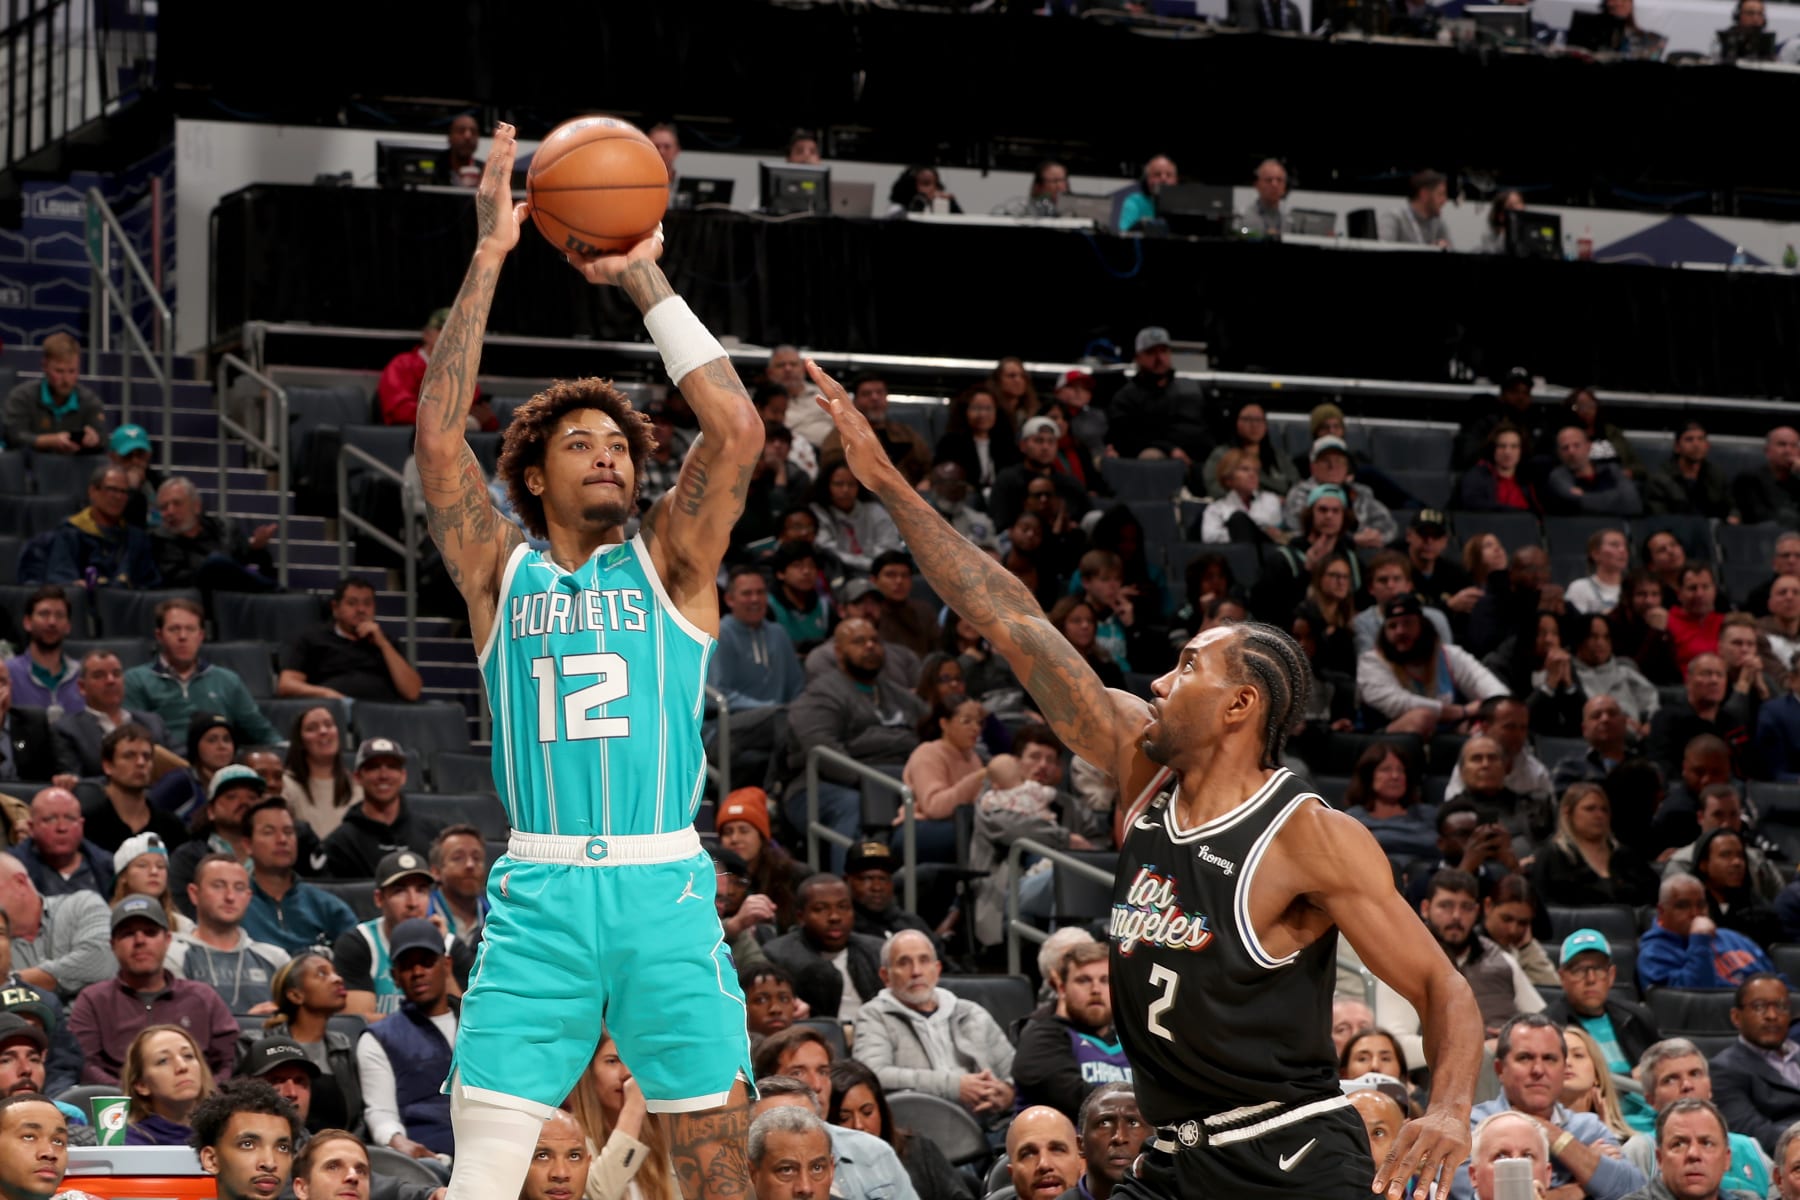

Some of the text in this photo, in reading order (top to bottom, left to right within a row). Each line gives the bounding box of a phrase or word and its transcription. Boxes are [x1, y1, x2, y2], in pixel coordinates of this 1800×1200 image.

[510, 588, 647, 640] HORNETS
[531, 652, 630, 743] 12
[1198, 845, 1234, 875] honey
[1110, 905, 1208, 953] ngeles
[1148, 962, 1180, 1042] 2
